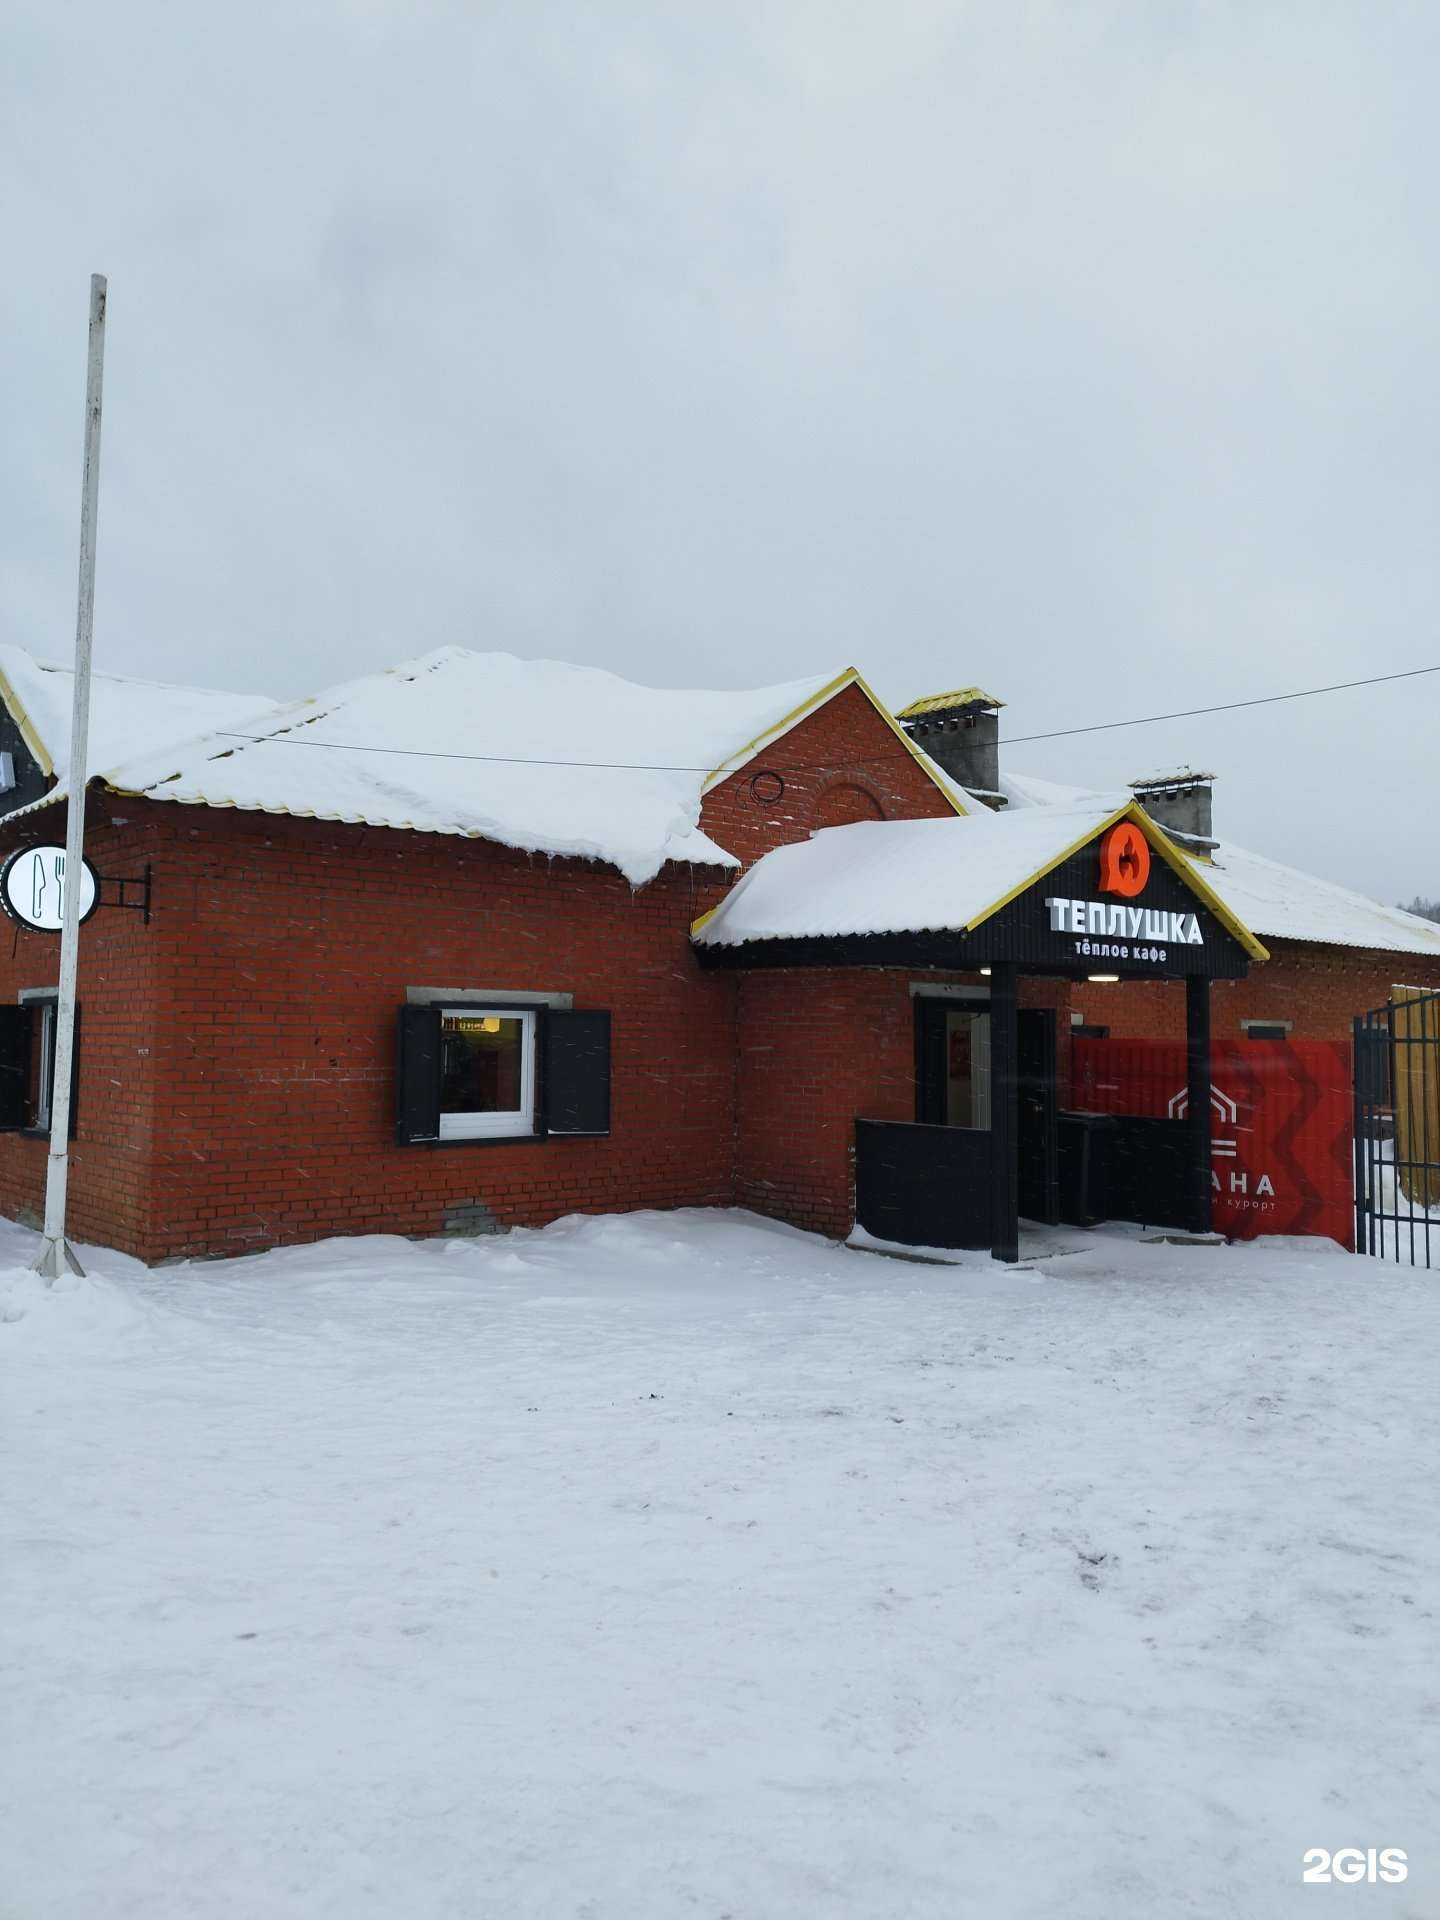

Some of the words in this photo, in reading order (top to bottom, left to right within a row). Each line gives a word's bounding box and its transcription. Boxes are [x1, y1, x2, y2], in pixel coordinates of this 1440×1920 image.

[1046, 897, 1204, 945] ТЕПЛУШКА
[1075, 938, 1129, 958] тёплое
[1133, 946, 1167, 962] кафе
[1227, 1199, 1276, 1211] курорт
